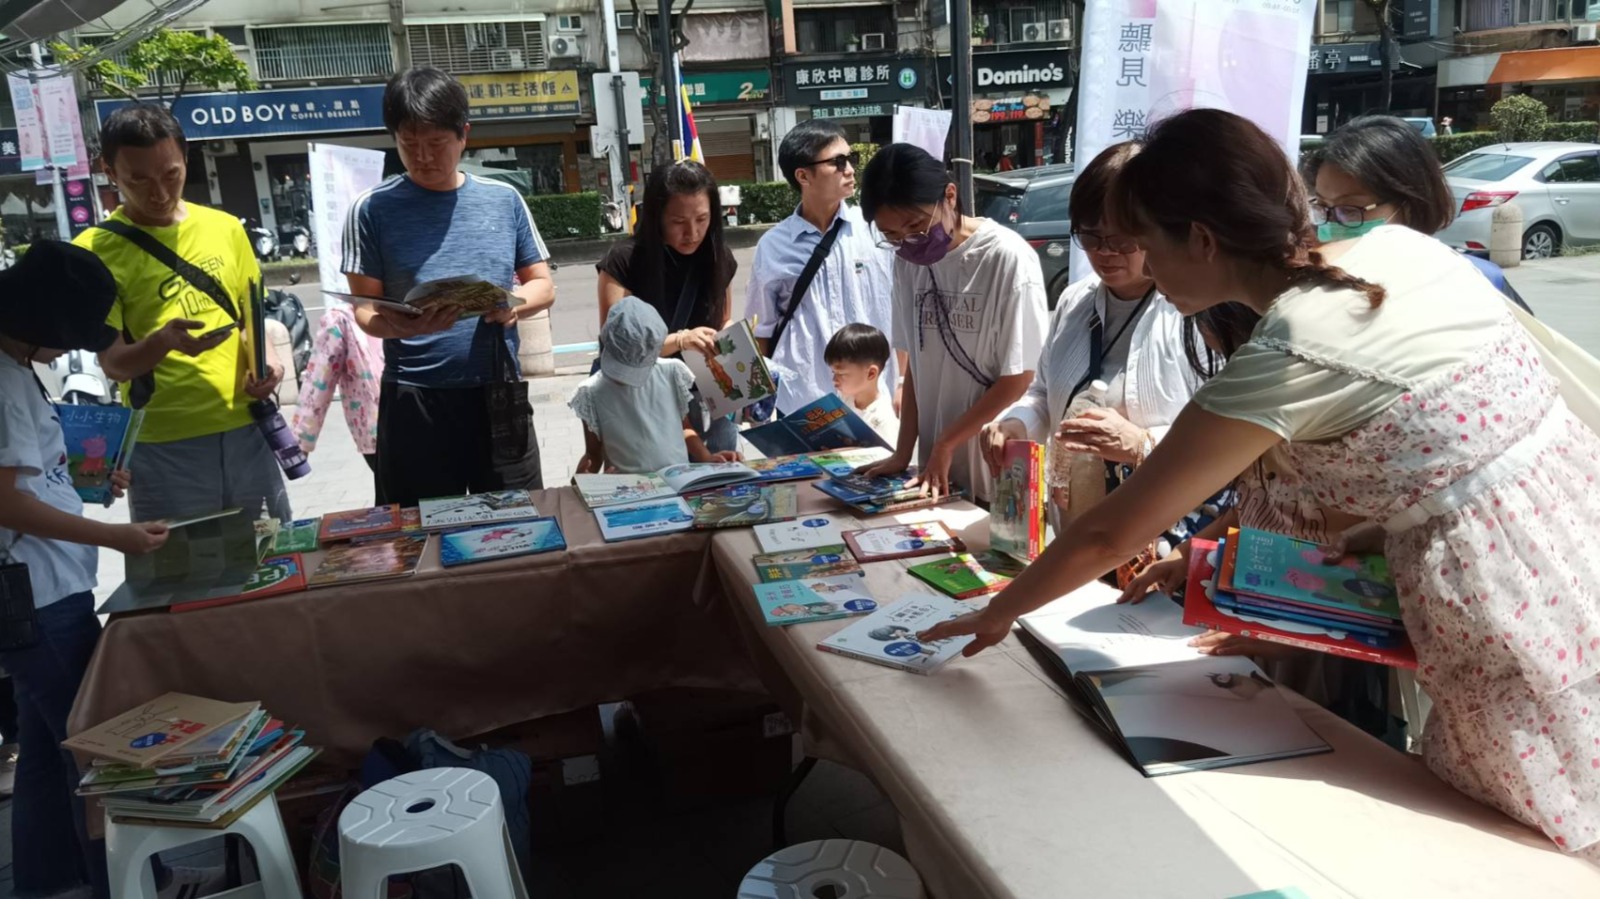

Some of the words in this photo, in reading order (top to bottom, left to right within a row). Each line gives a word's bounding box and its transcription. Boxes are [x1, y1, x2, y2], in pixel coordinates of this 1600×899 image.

[795, 64, 890, 85] 康欣中醫診所
[977, 62, 1064, 86] Domino's
[191, 106, 237, 125] OLD
[241, 103, 286, 123] BOY
